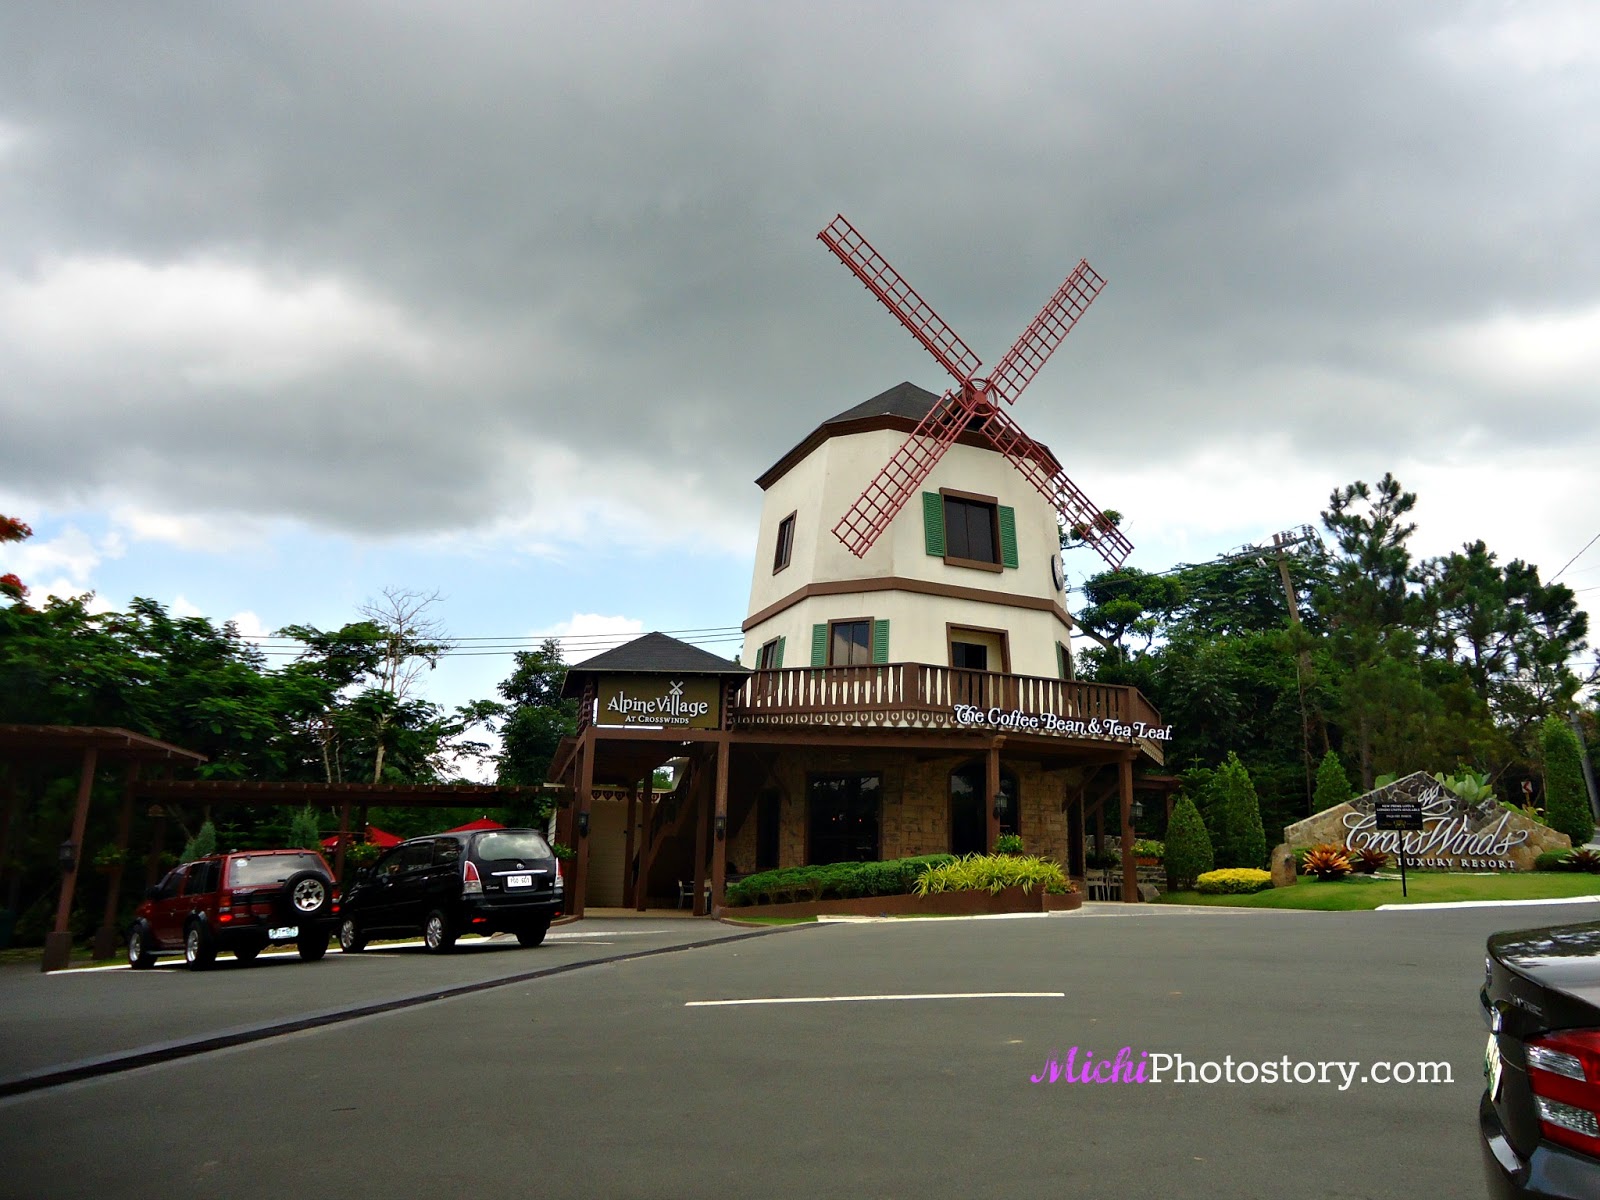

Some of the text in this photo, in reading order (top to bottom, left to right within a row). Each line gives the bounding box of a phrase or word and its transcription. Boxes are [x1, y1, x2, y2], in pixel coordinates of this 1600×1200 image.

[607, 691, 708, 717] Alpine Village
[638, 715, 690, 724] CROSSWINDS
[954, 704, 984, 725] The
[987, 707, 1038, 728] Coffee
[1040, 713, 1087, 736] Bean
[1088, 718, 1103, 734] &
[1102, 718, 1132, 736] Tea
[1397, 857, 1516, 869] LUXURY RESORT
